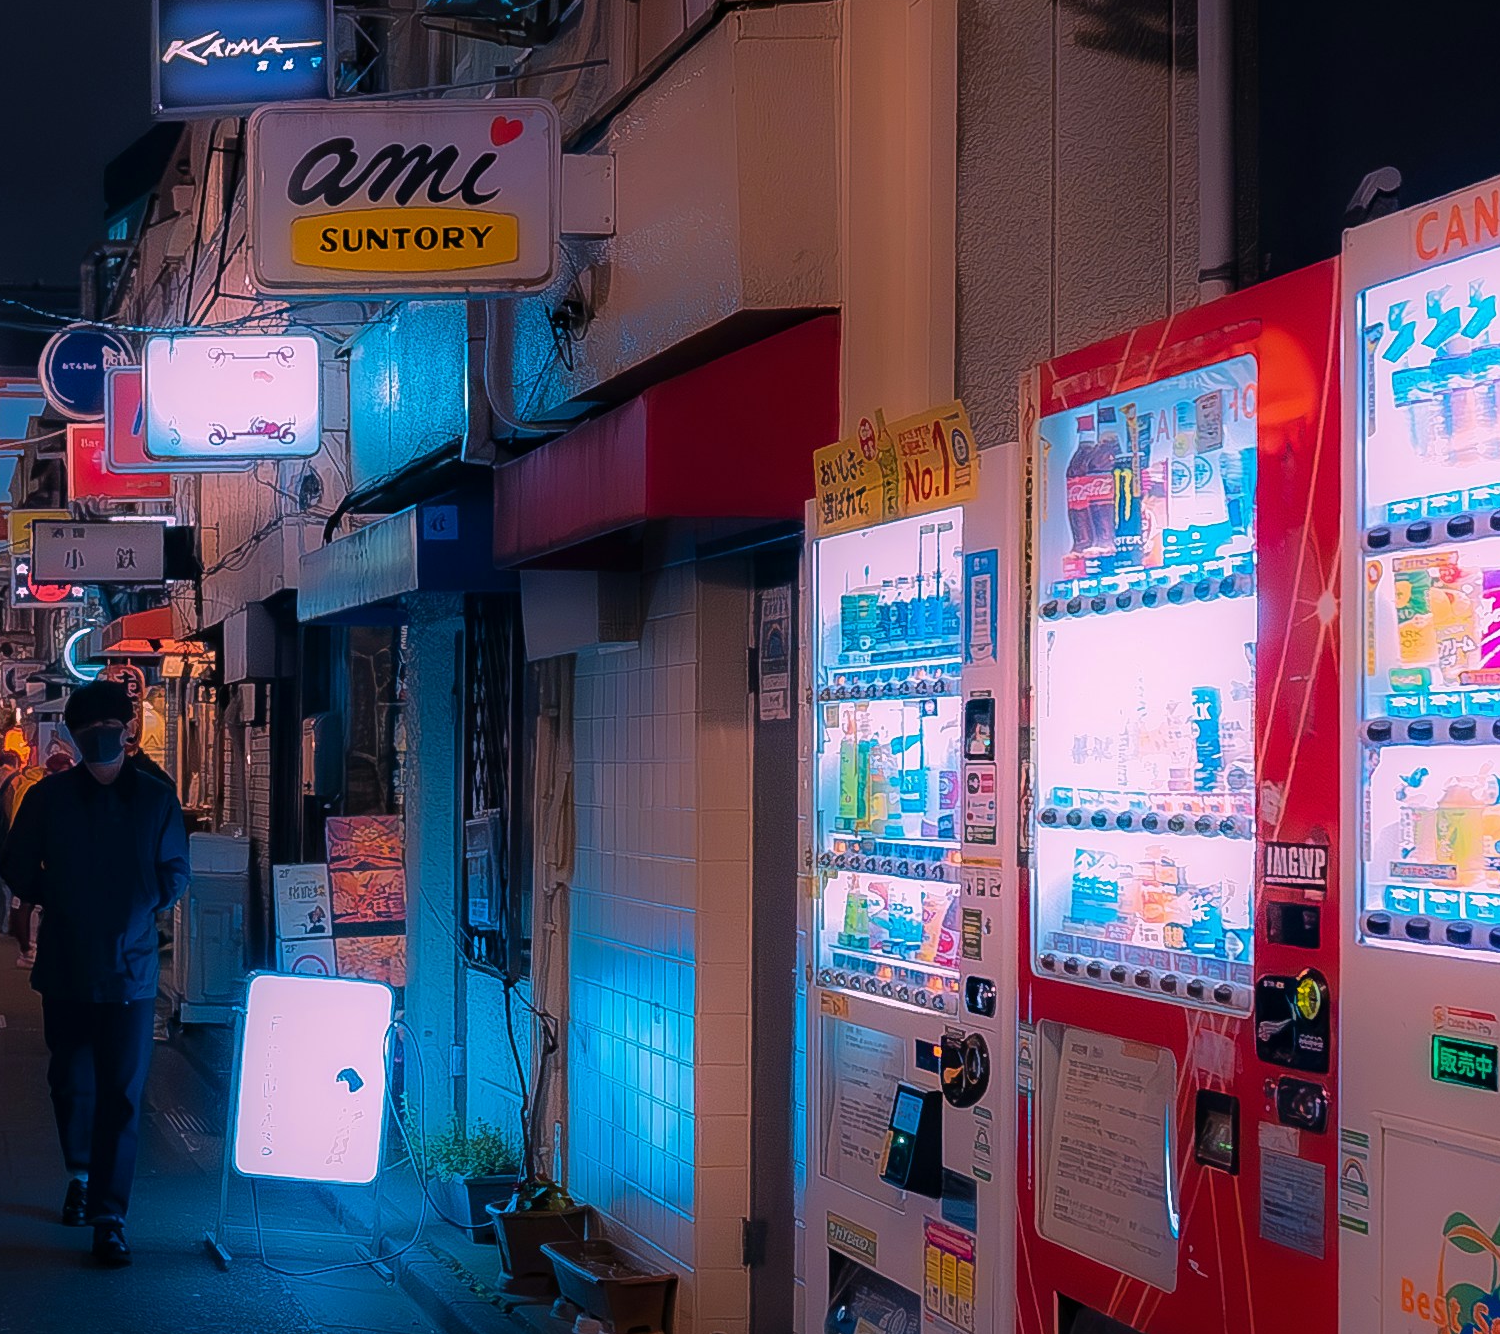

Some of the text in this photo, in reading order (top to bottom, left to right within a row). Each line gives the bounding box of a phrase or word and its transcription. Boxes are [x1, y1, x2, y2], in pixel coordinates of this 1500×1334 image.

[286, 125, 510, 208] ami
[318, 225, 494, 253] SUNTORY
[1399, 1276, 1463, 1333] Best
